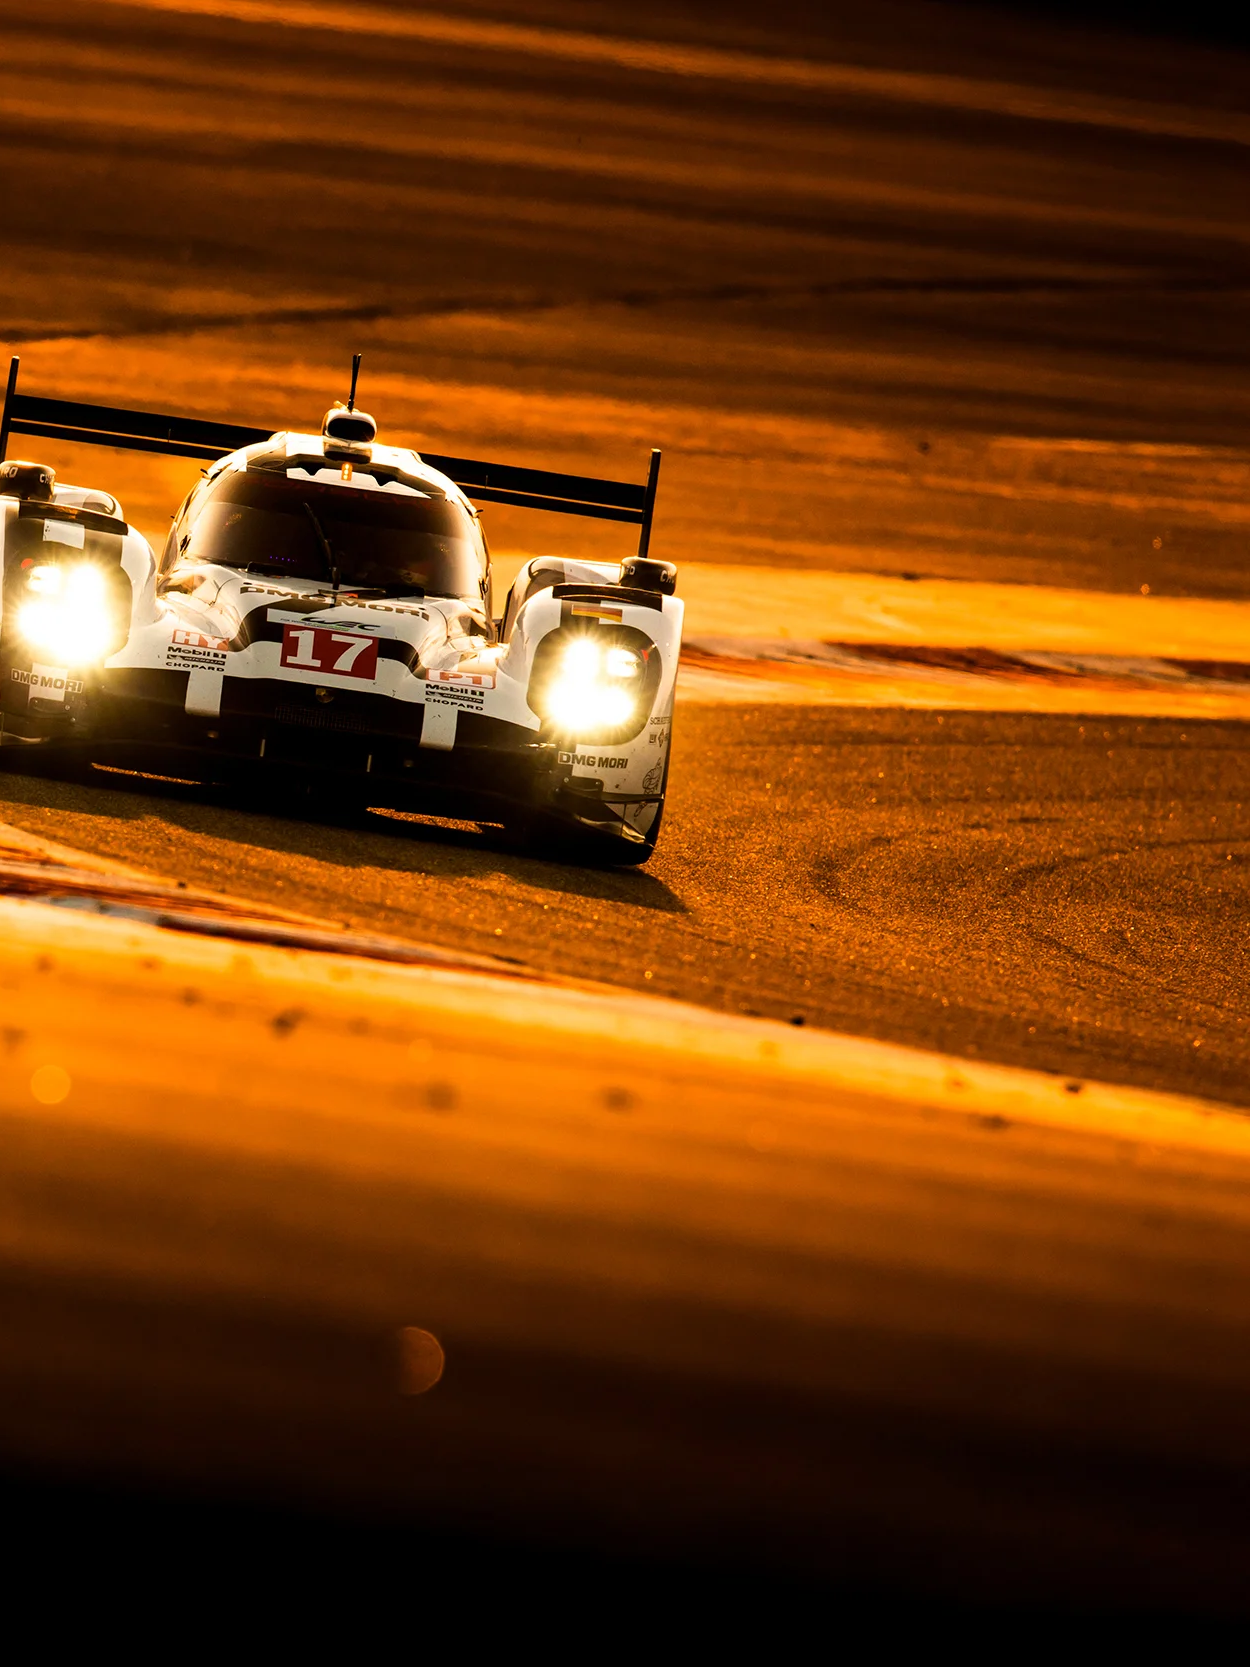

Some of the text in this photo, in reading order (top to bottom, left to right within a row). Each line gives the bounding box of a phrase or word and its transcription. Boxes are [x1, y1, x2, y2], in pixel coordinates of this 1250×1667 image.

[334, 598, 430, 621] MORI
[174, 629, 228, 649] HY
[167, 646, 210, 657] Mobil
[286, 629, 373, 672] 17
[166, 661, 225, 672] CHOPARD
[11, 669, 83, 693] DMG MORI
[428, 669, 493, 689] P1
[425, 683, 468, 694] Mobil
[425, 697, 484, 711] CHOPARD
[558, 752, 629, 769] DMG MORI
